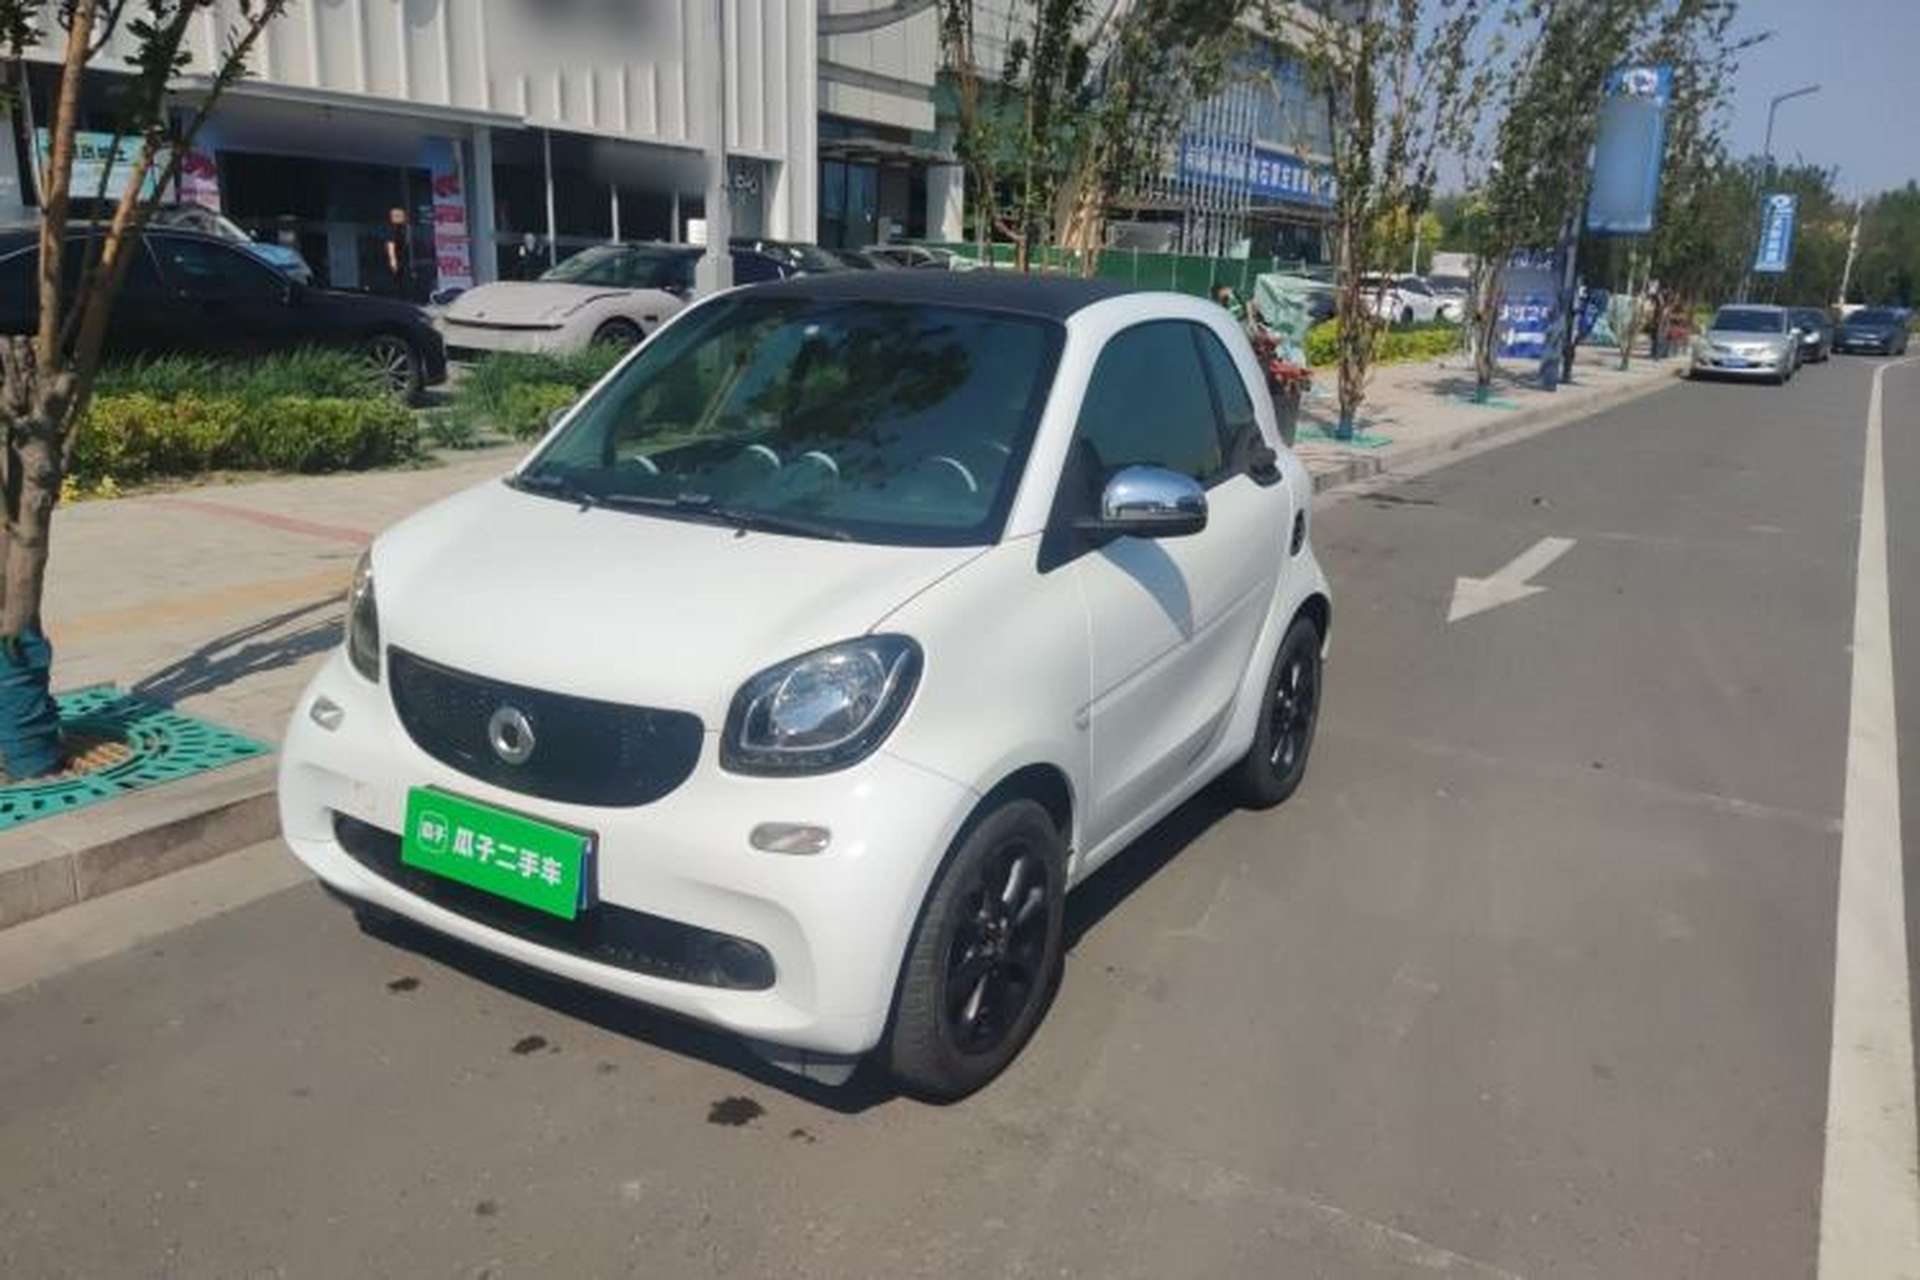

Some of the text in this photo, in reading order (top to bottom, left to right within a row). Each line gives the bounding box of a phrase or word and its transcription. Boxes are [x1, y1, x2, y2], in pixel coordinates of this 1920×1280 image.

[453, 826, 563, 887] 瓜子二手车
